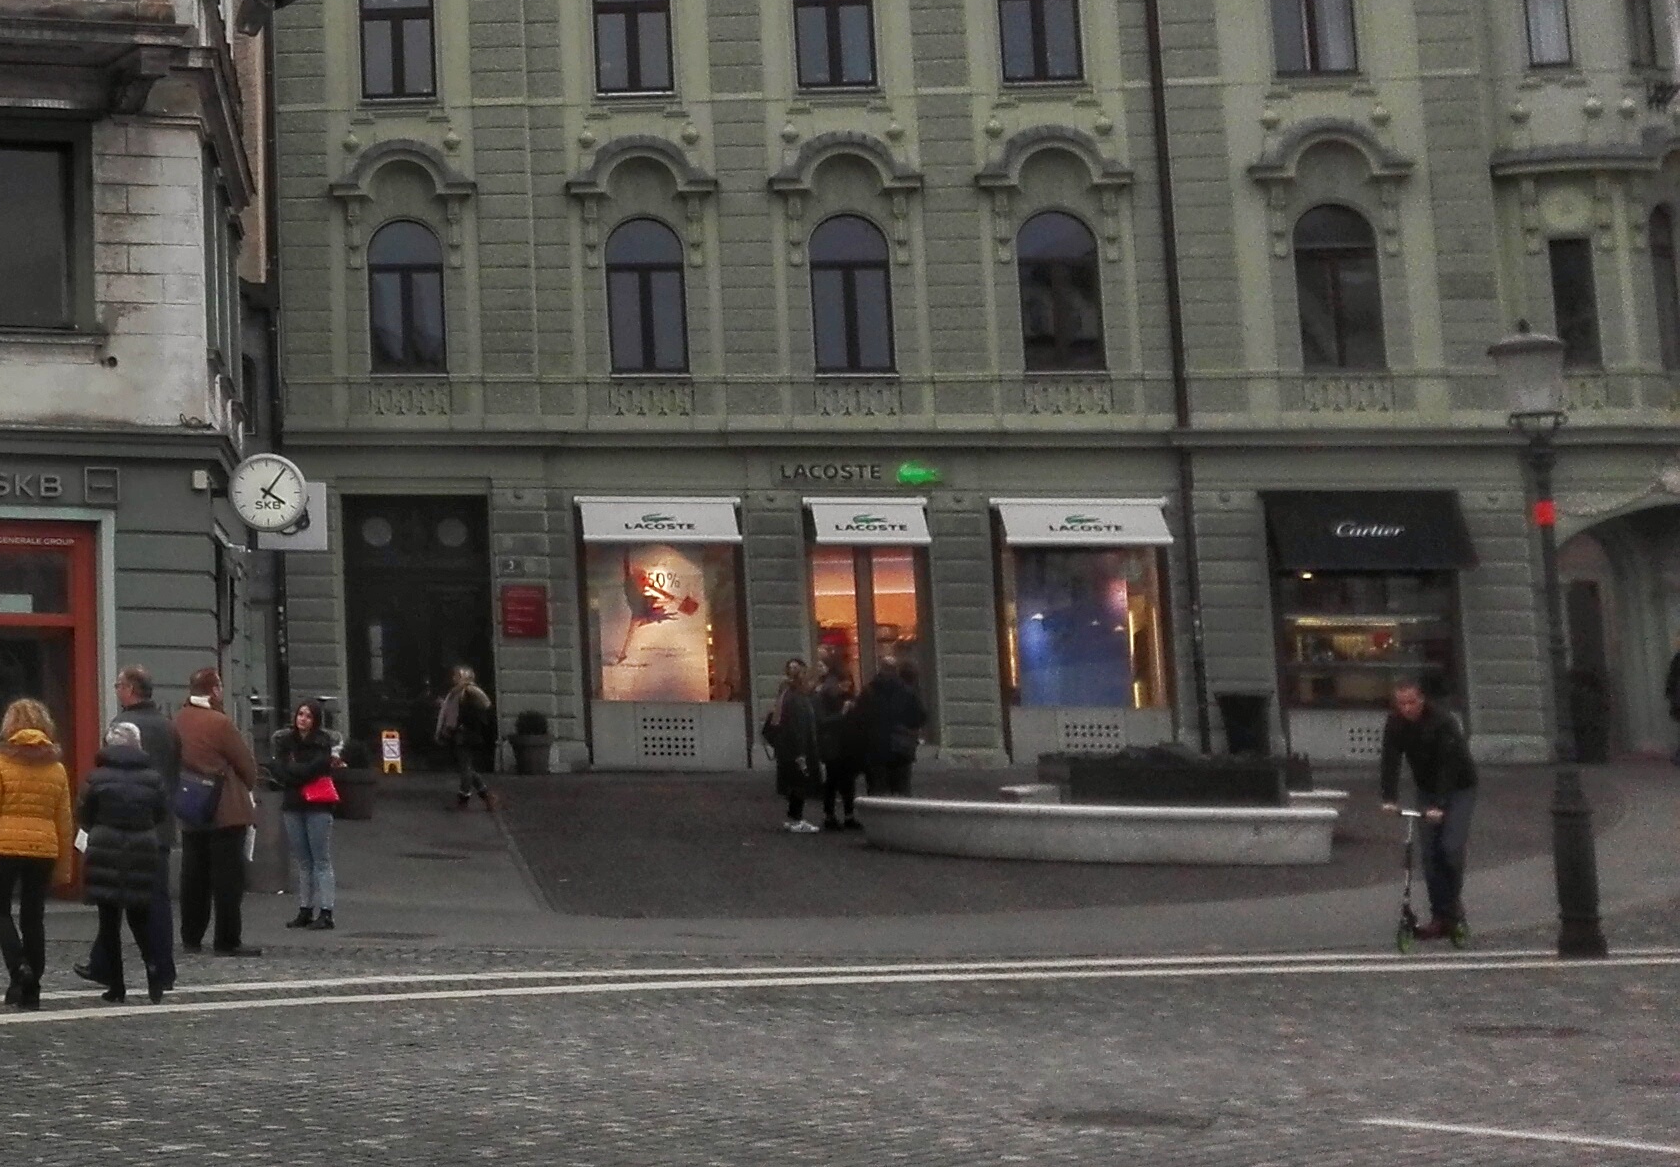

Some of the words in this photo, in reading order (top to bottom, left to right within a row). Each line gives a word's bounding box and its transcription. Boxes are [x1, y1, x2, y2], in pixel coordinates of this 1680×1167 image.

[780, 464, 882, 480] LACOSTE
[255, 500, 282, 510] SKB
[624, 522, 696, 531] LACOSTE
[835, 524, 908, 532] LACOSTE
[1048, 524, 1122, 532] LACOSTE
[1336, 521, 1406, 537] Cartier
[43, 537, 75, 546] GROUP
